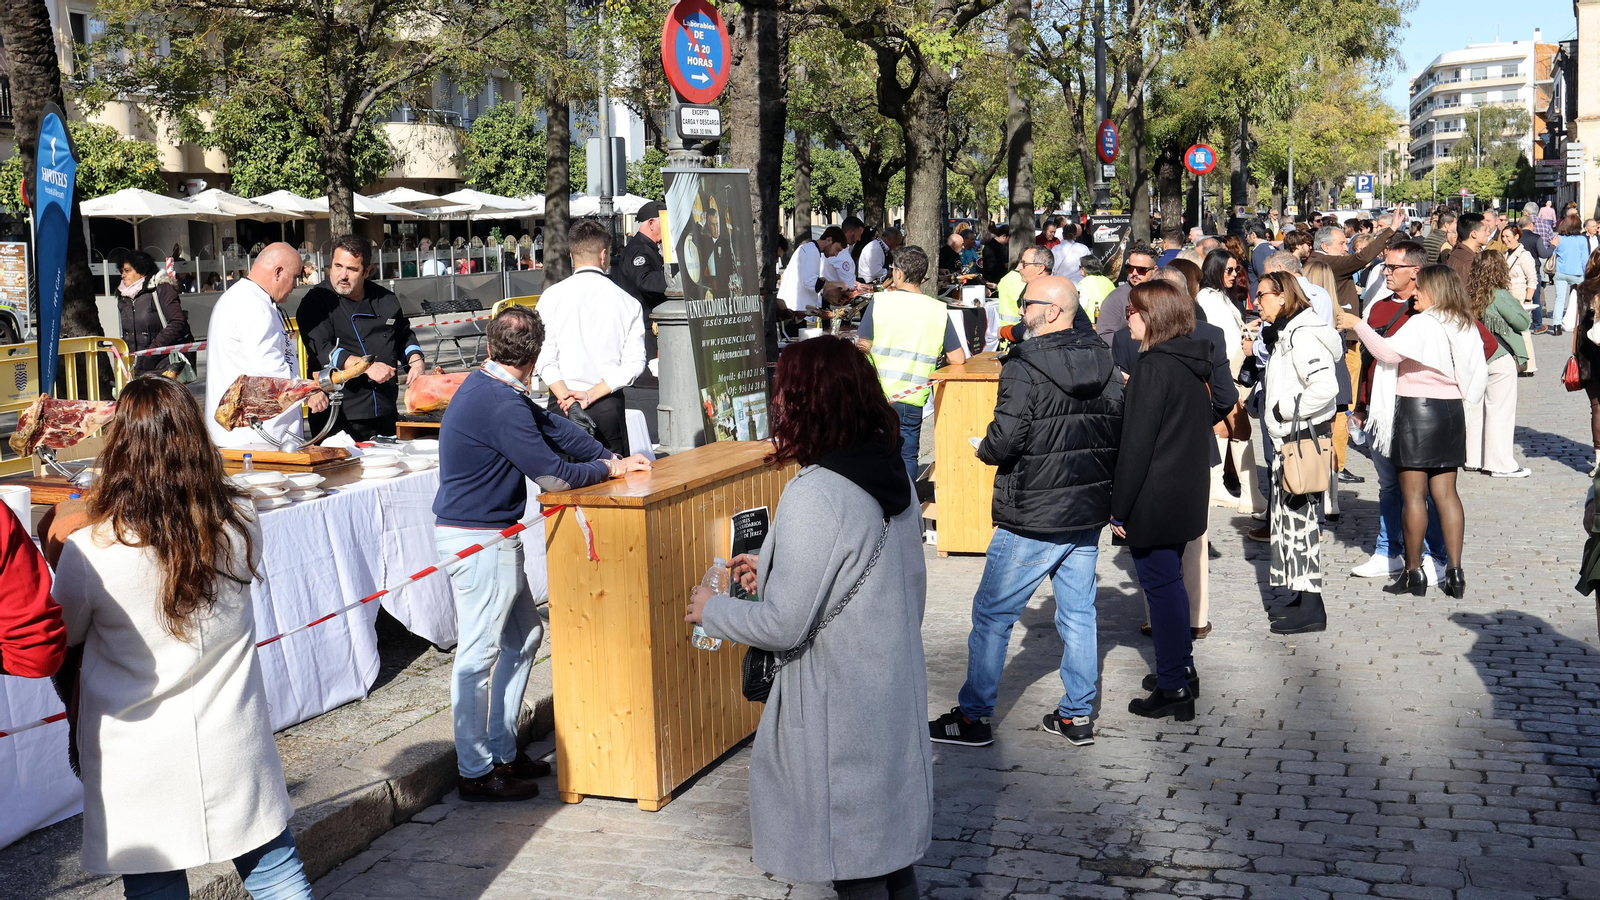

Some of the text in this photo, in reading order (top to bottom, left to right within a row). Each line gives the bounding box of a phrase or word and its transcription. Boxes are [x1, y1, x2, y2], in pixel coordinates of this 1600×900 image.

[682, 19, 716, 31] Laborables
[693, 30, 705, 40] DE
[687, 42, 711, 54] 7 A 20
[687, 56, 713, 68] HORAS
[41, 166, 68, 189] HIPOTELS
[1358, 176, 1369, 190] P
[702, 315, 752, 327] JESÚS DELGADO
